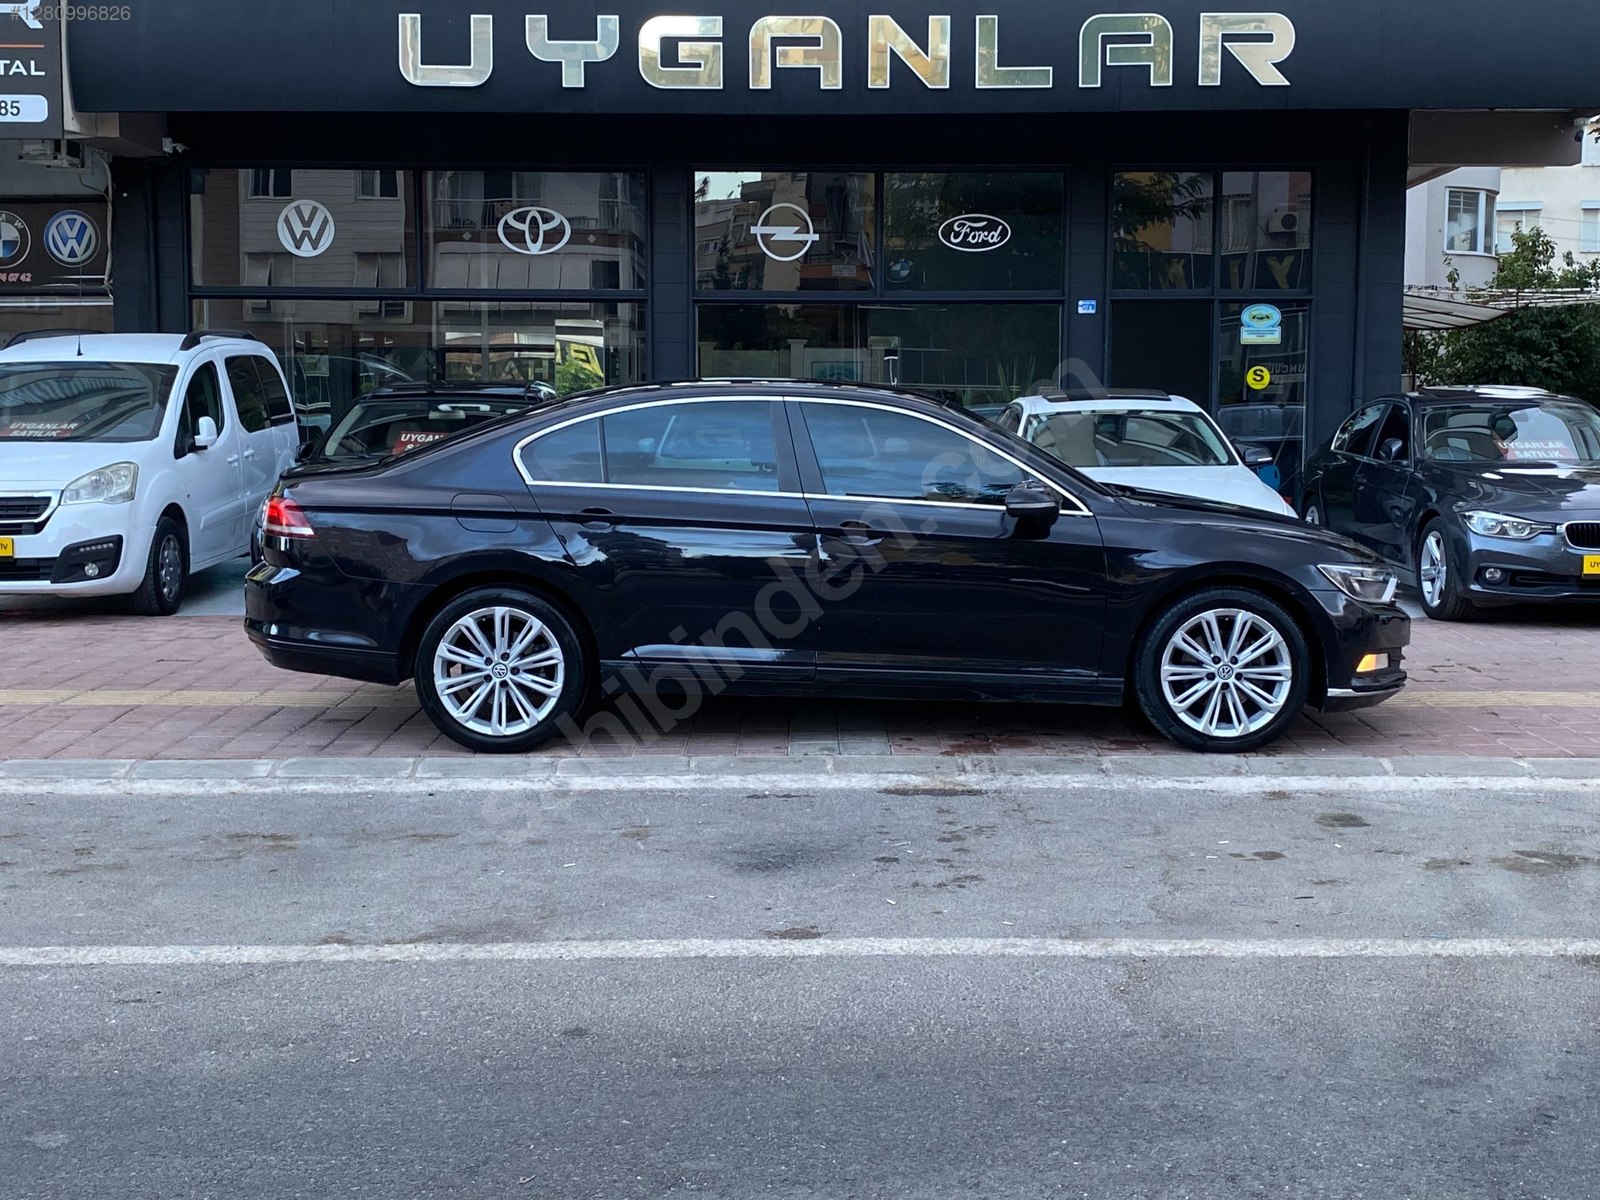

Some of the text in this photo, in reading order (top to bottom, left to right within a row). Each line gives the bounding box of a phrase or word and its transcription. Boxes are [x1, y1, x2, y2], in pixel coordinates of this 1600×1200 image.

[398, 12, 1296, 90] UYGANLAR
[0, 60, 46, 76] TAL
[0, 100, 20, 117] 85
[950, 220, 1003, 244] Ford
[1252, 368, 1265, 382] S
[9, 422, 79, 430] UYGANLAR
[1498, 441, 1566, 450] UYGANLAR
